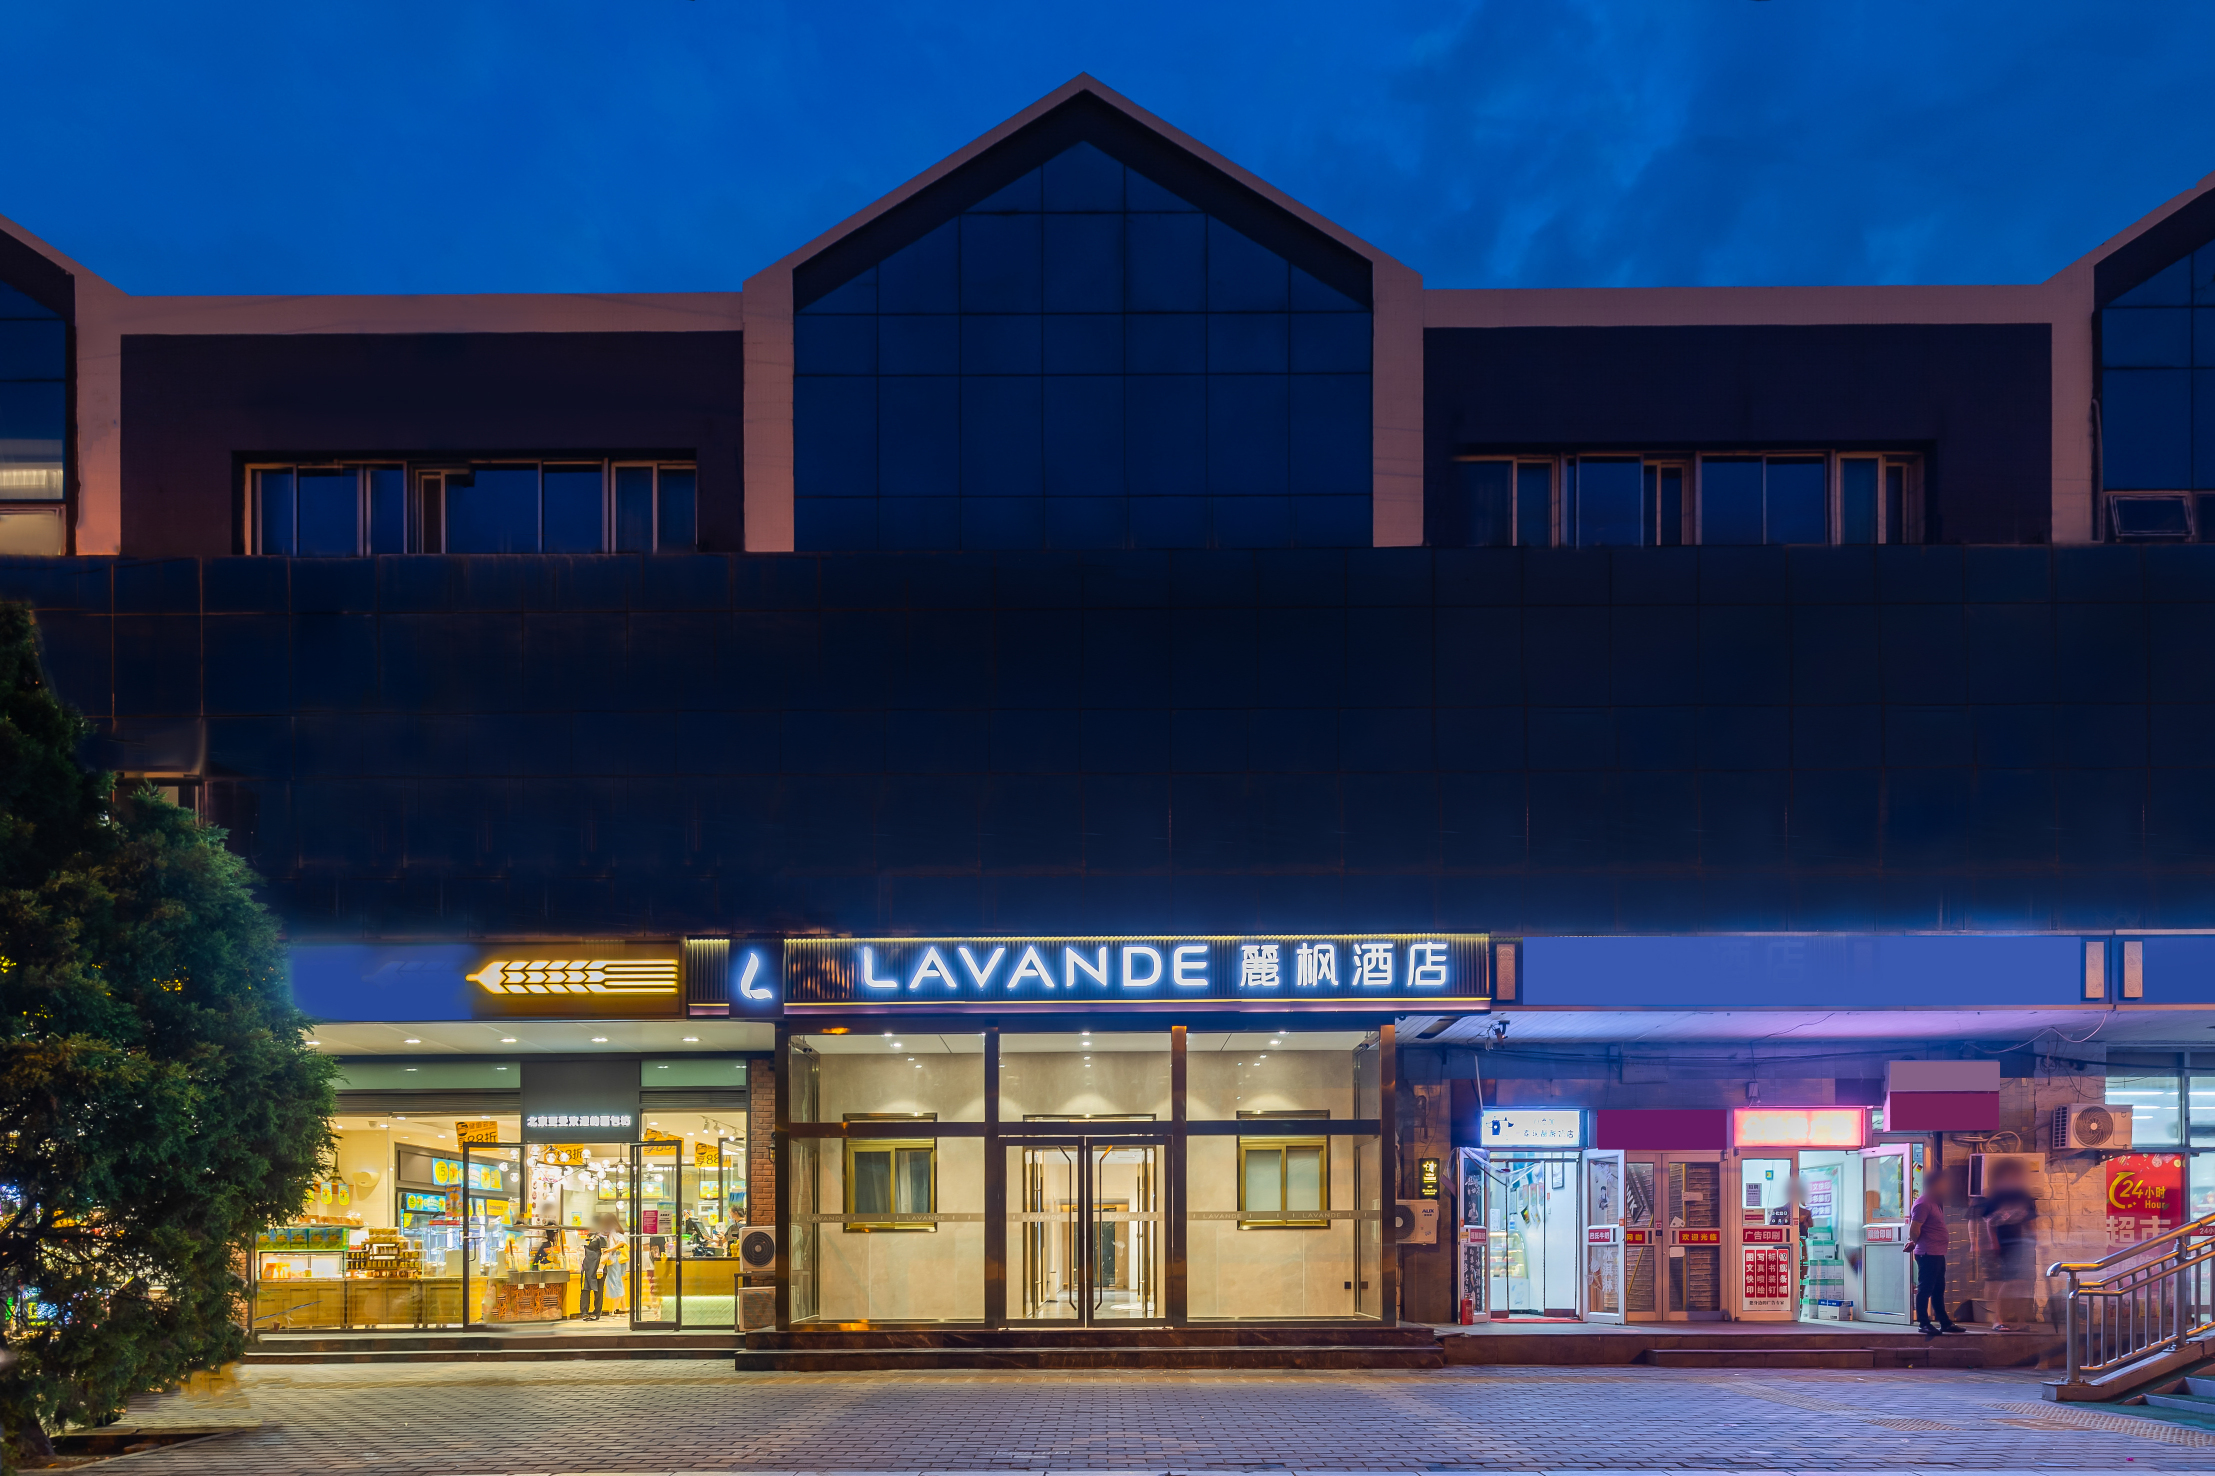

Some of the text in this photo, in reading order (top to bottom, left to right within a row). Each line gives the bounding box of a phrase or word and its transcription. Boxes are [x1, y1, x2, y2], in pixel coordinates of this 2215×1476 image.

[862, 942, 1448, 988] LAVANDE 麗枫酒店
[2119, 1179, 2166, 1199] 24小时
[2144, 1199, 2166, 1209] Hour
[1589, 1231, 1610, 1240] 巴氏牛奶
[1681, 1233, 1718, 1241] 欢迎光临
[1744, 1231, 1781, 1241] 广告印刷
[2106, 1215, 2171, 1248] 超市
[1745, 1252, 1755, 1295] 图文快印
[1756, 1253, 1765, 1295] 写真喷绘
[1767, 1252, 1777, 1295] 标书装订
